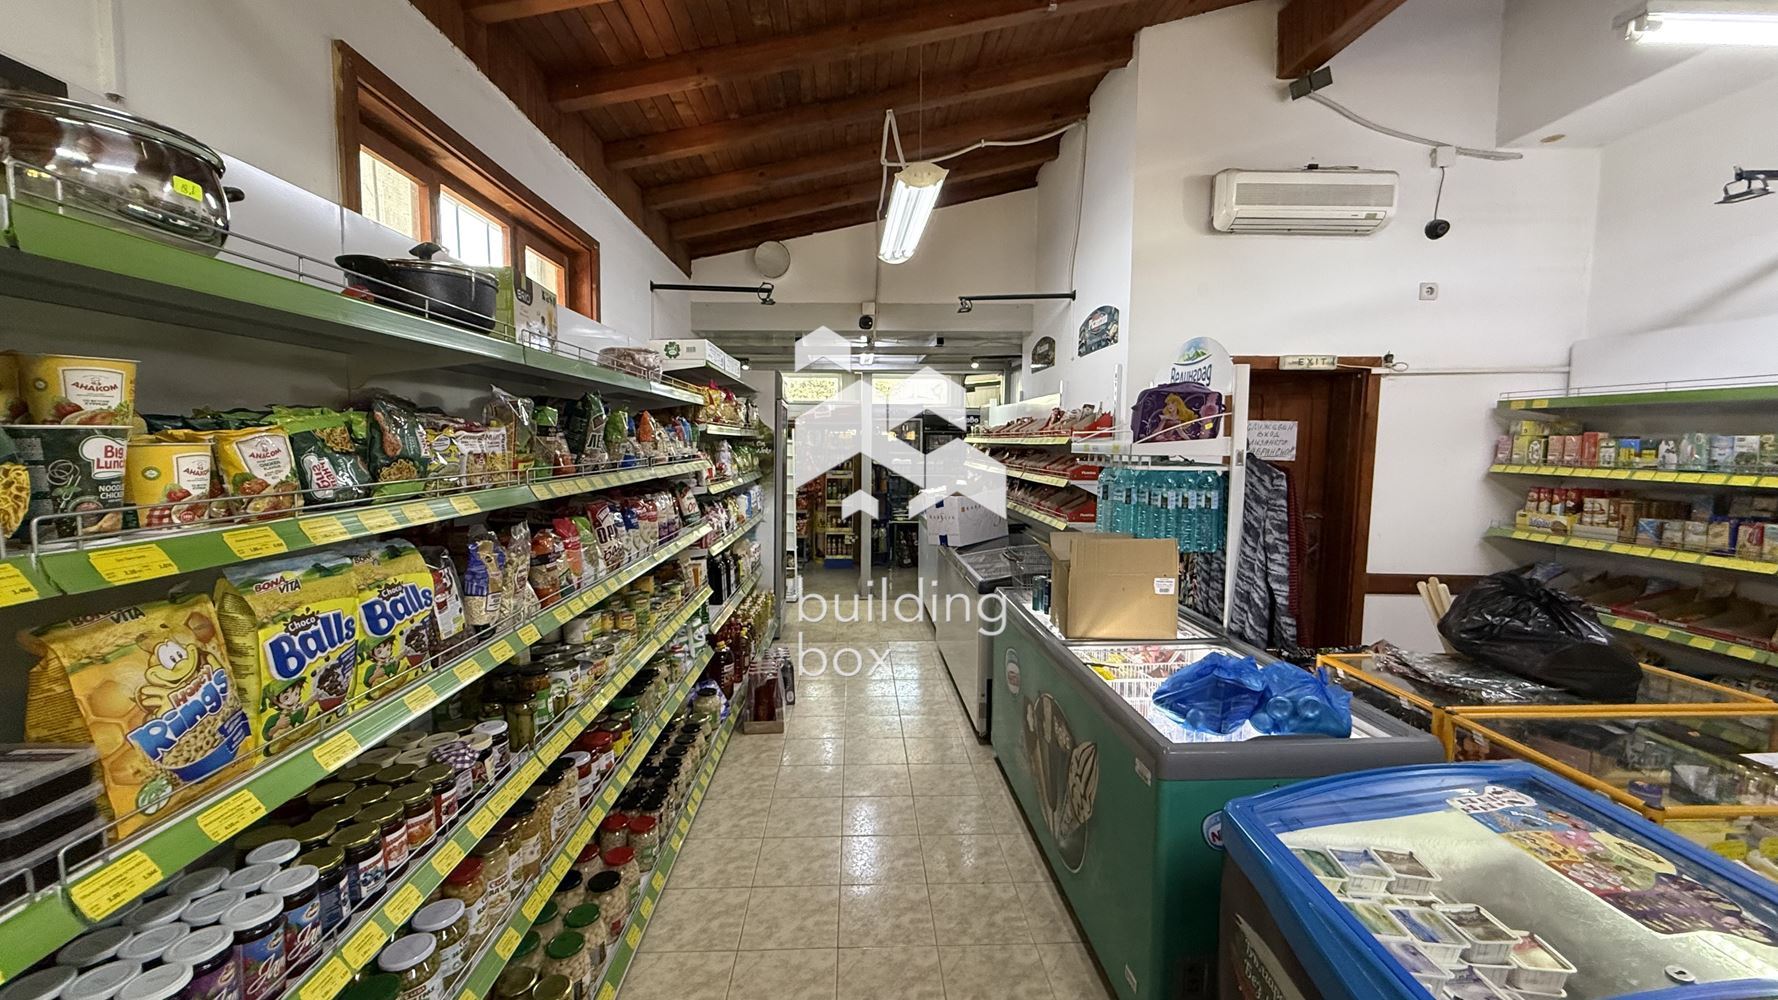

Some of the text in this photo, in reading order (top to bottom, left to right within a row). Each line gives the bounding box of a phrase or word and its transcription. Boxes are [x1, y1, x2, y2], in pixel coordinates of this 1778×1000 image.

[1298, 358, 1327, 366] EXIT
[96, 458, 124, 470] Lunc
[253, 575, 302, 594] BONA VITA
[381, 585, 403, 598] Choco
[110, 605, 146, 624] VITA
[361, 584, 432, 637] Balls
[287, 615, 317, 632] Choco
[268, 612, 356, 681] Balls
[127, 669, 229, 762] Rings
